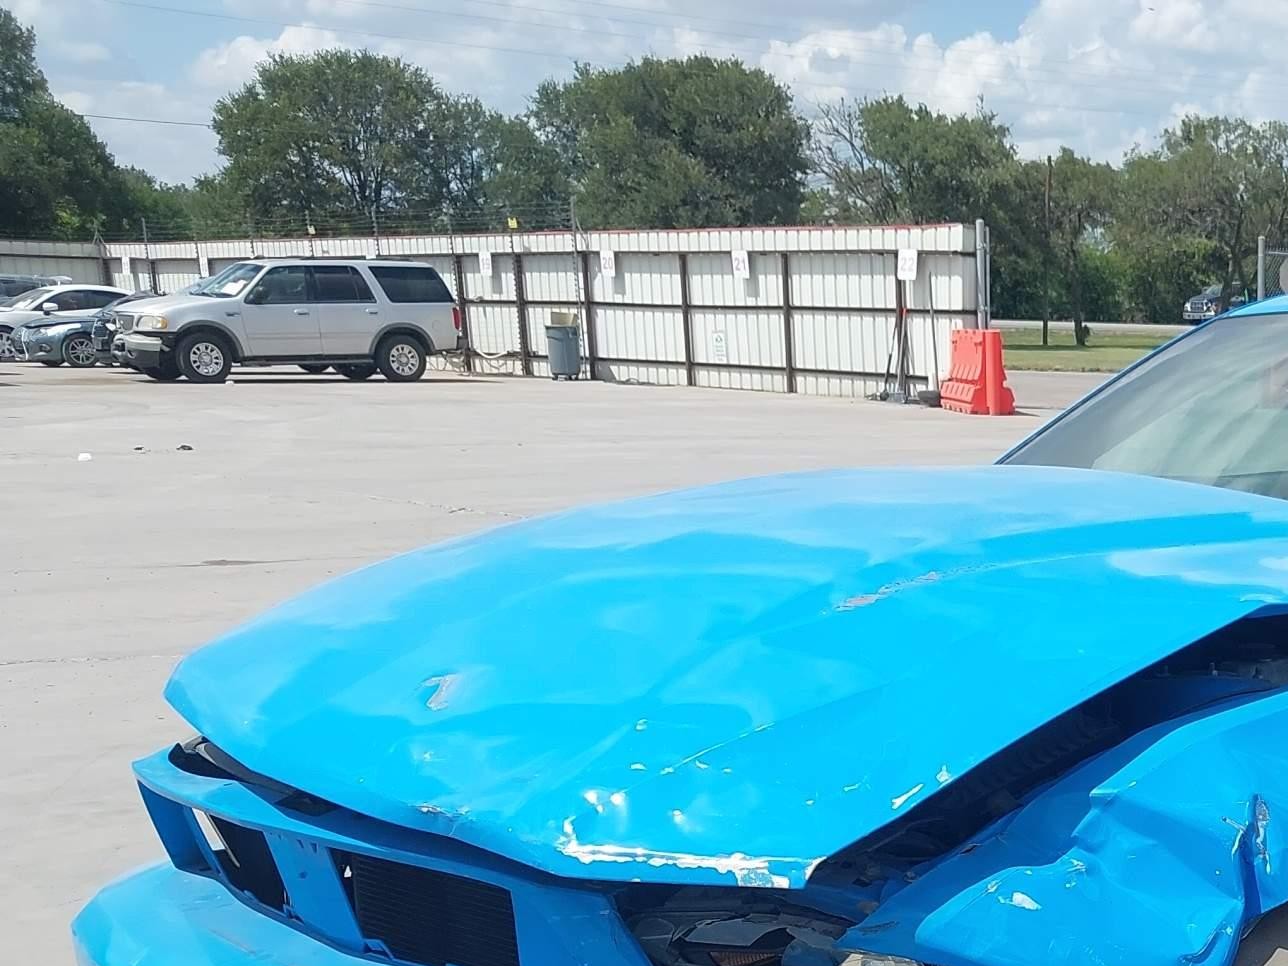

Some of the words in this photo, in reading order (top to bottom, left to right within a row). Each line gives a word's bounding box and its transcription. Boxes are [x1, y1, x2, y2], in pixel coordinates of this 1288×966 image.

[602, 257, 614, 270] 20
[735, 257, 747, 271] 21
[900, 257, 914, 271] 22
